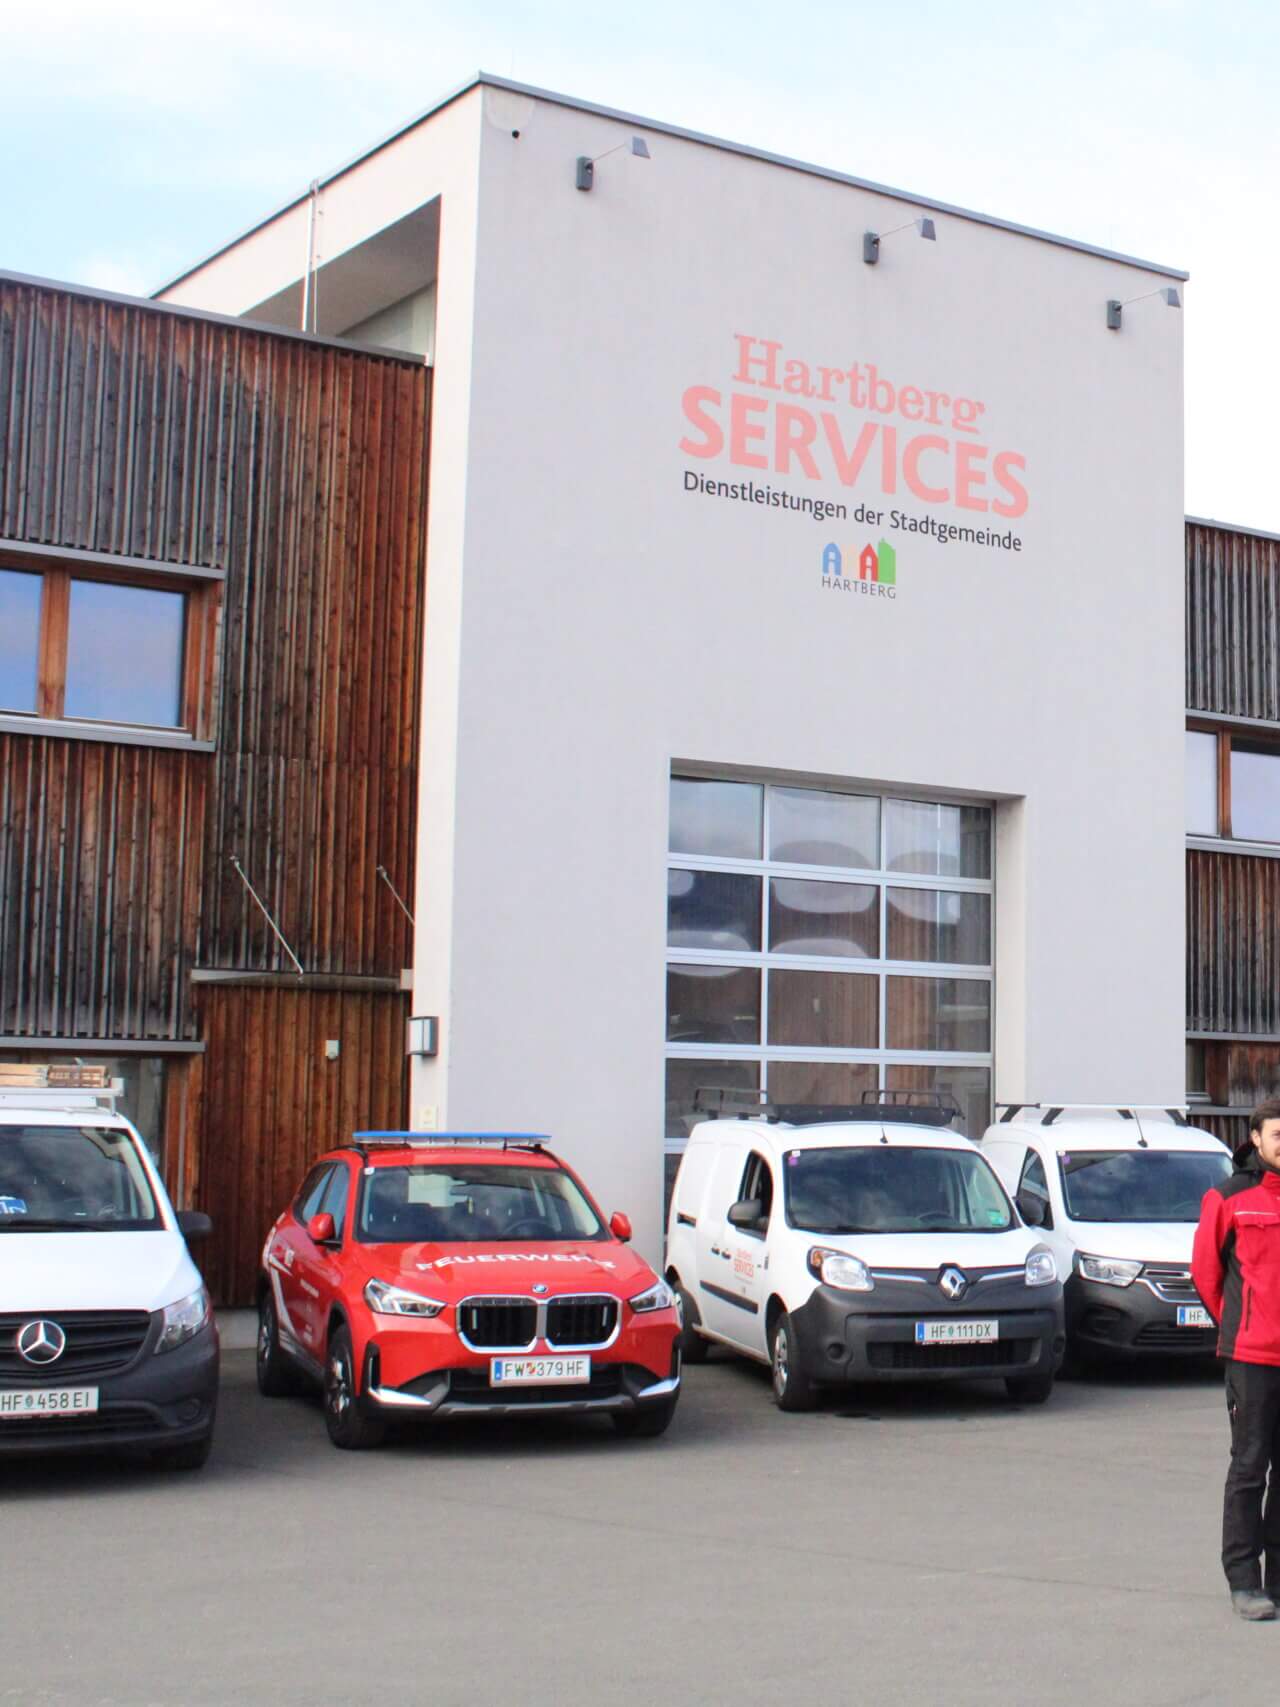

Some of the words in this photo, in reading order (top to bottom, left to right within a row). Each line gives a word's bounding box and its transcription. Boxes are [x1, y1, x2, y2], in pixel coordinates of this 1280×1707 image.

[732, 334, 986, 434] Hartberg
[678, 385, 1030, 519] SERVICES
[684, 471, 847, 521] Dienstleistungen
[854, 503, 884, 526] der
[889, 510, 1023, 552] Stadtgemeinde
[821, 575, 897, 600] HARTBERG
[415, 1253, 617, 1272] FEUERWEHR
[1189, 1311, 1202, 1321] HF
[930, 1326, 946, 1338] HF
[957, 1325, 973, 1338] 111
[976, 1324, 991, 1337] DX
[504, 1363, 525, 1377] FW
[536, 1361, 564, 1376] 379
[566, 1360, 585, 1375] HF
[1, 1394, 23, 1412] HF
[37, 1392, 69, 1409] 458
[73, 1391, 90, 1408] EI
